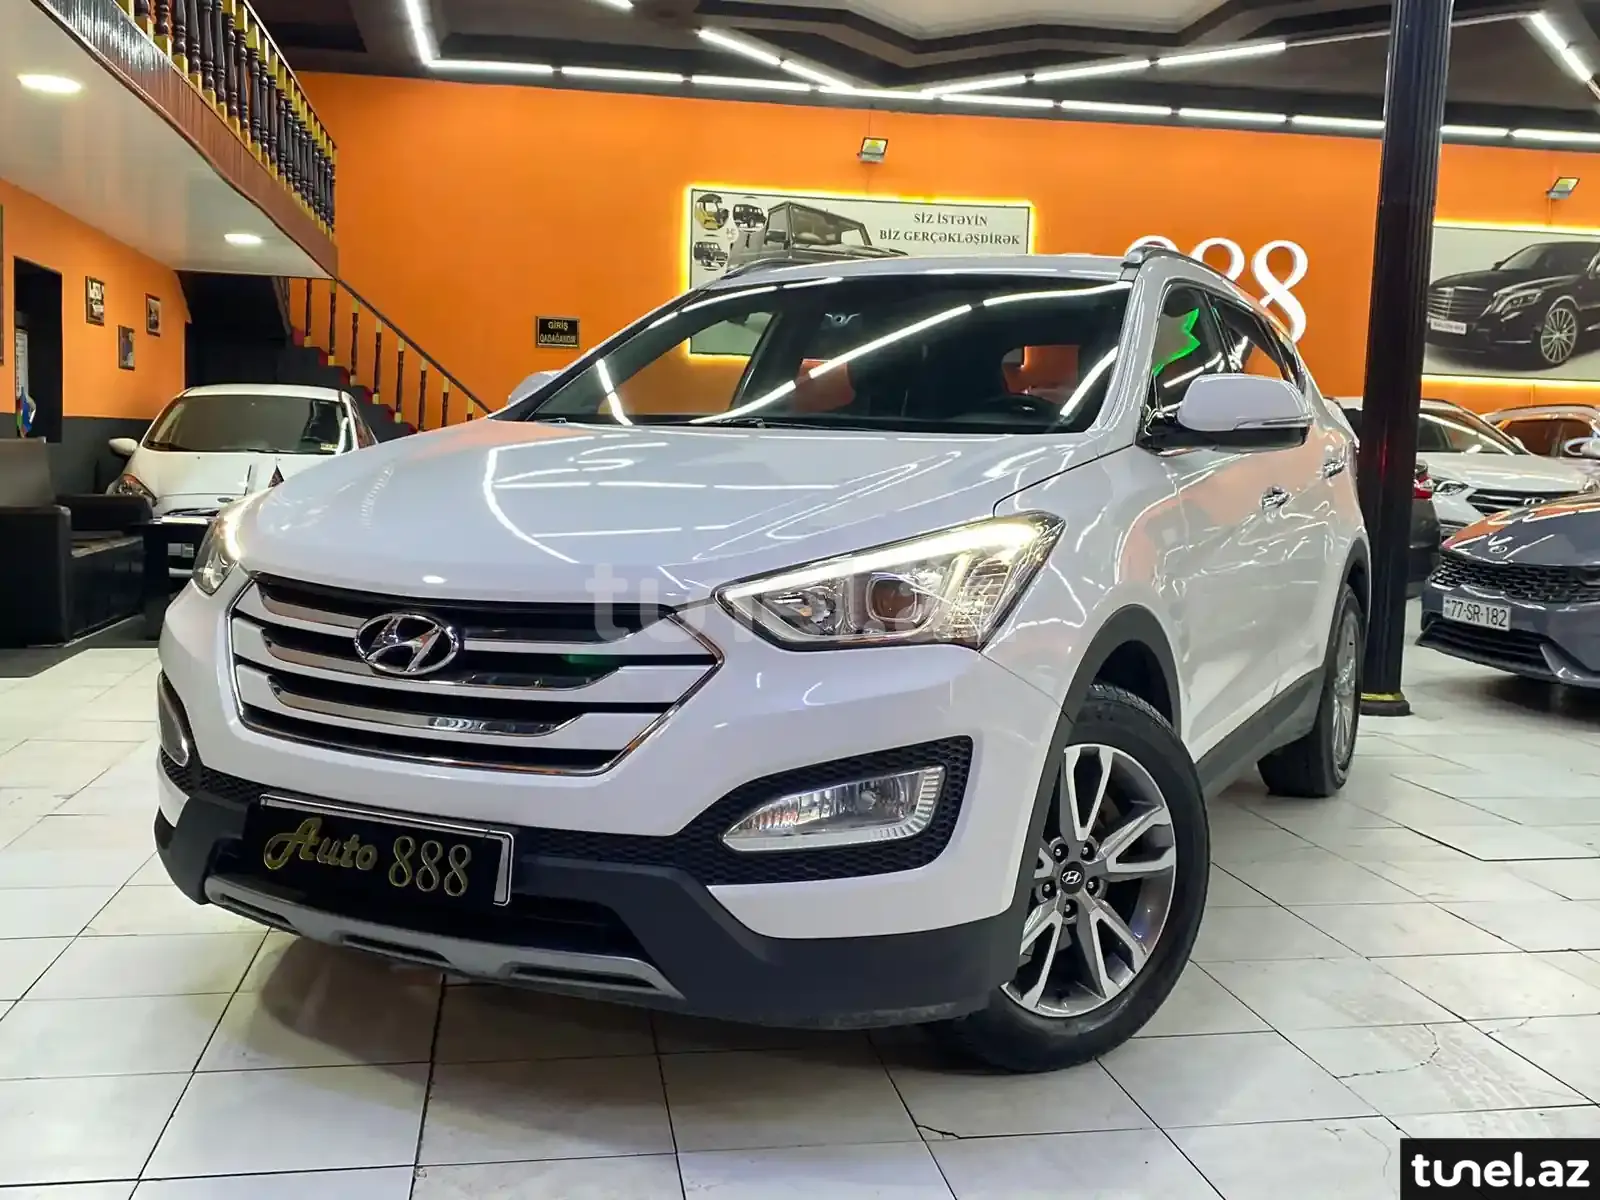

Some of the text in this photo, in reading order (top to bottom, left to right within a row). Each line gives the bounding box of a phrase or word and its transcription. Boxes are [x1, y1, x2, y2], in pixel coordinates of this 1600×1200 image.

[914, 211, 988, 226] SİZ İSTƏYİN
[879, 228, 901, 241] BİZ
[263, 817, 472, 897] Auto 888
